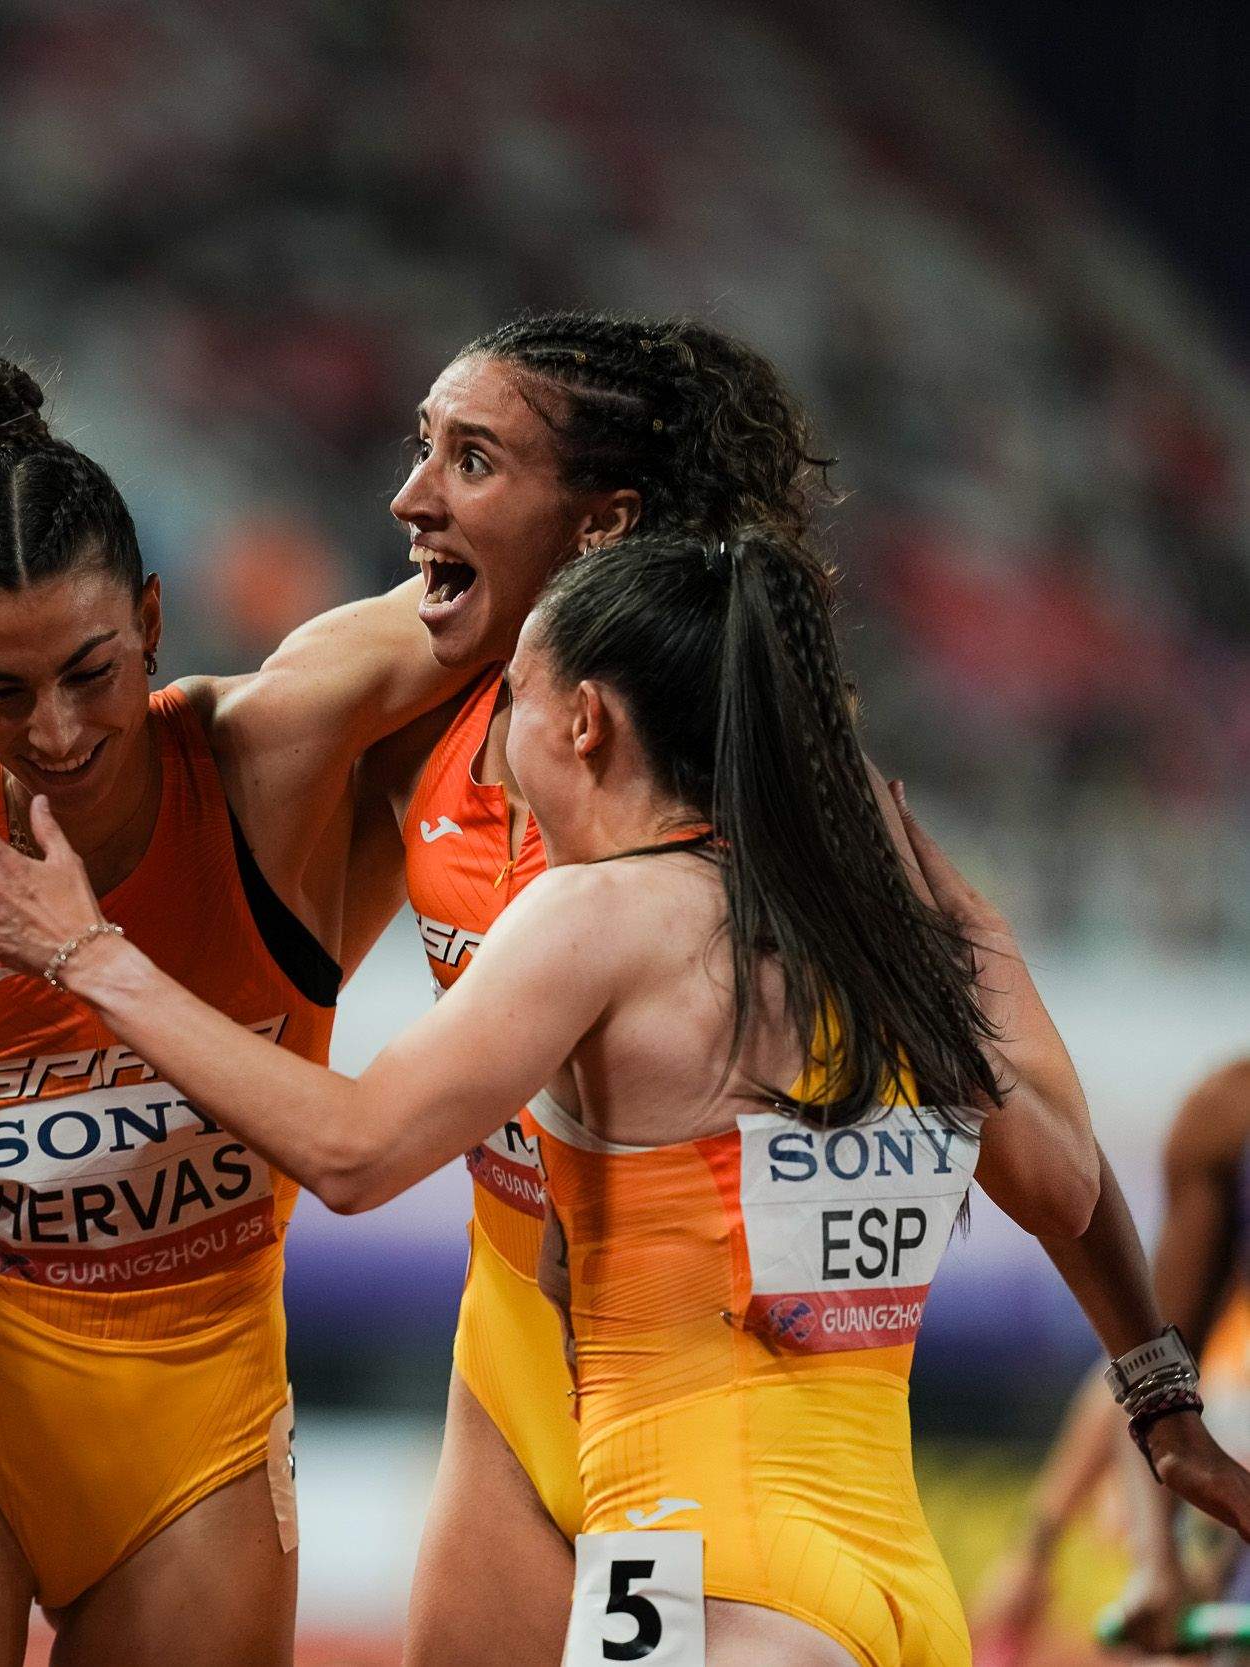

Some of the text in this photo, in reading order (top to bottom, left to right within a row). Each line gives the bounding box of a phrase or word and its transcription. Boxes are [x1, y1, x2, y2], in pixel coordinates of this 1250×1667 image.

[491, 1164, 542, 1205] GUAN
[767, 1128, 956, 1182] SONY
[44, 1215, 265, 1285] GUANGZHOU 25
[822, 1206, 927, 1280] ESP
[821, 1301, 925, 1334] GUANGZHO
[602, 1559, 663, 1662] 5
